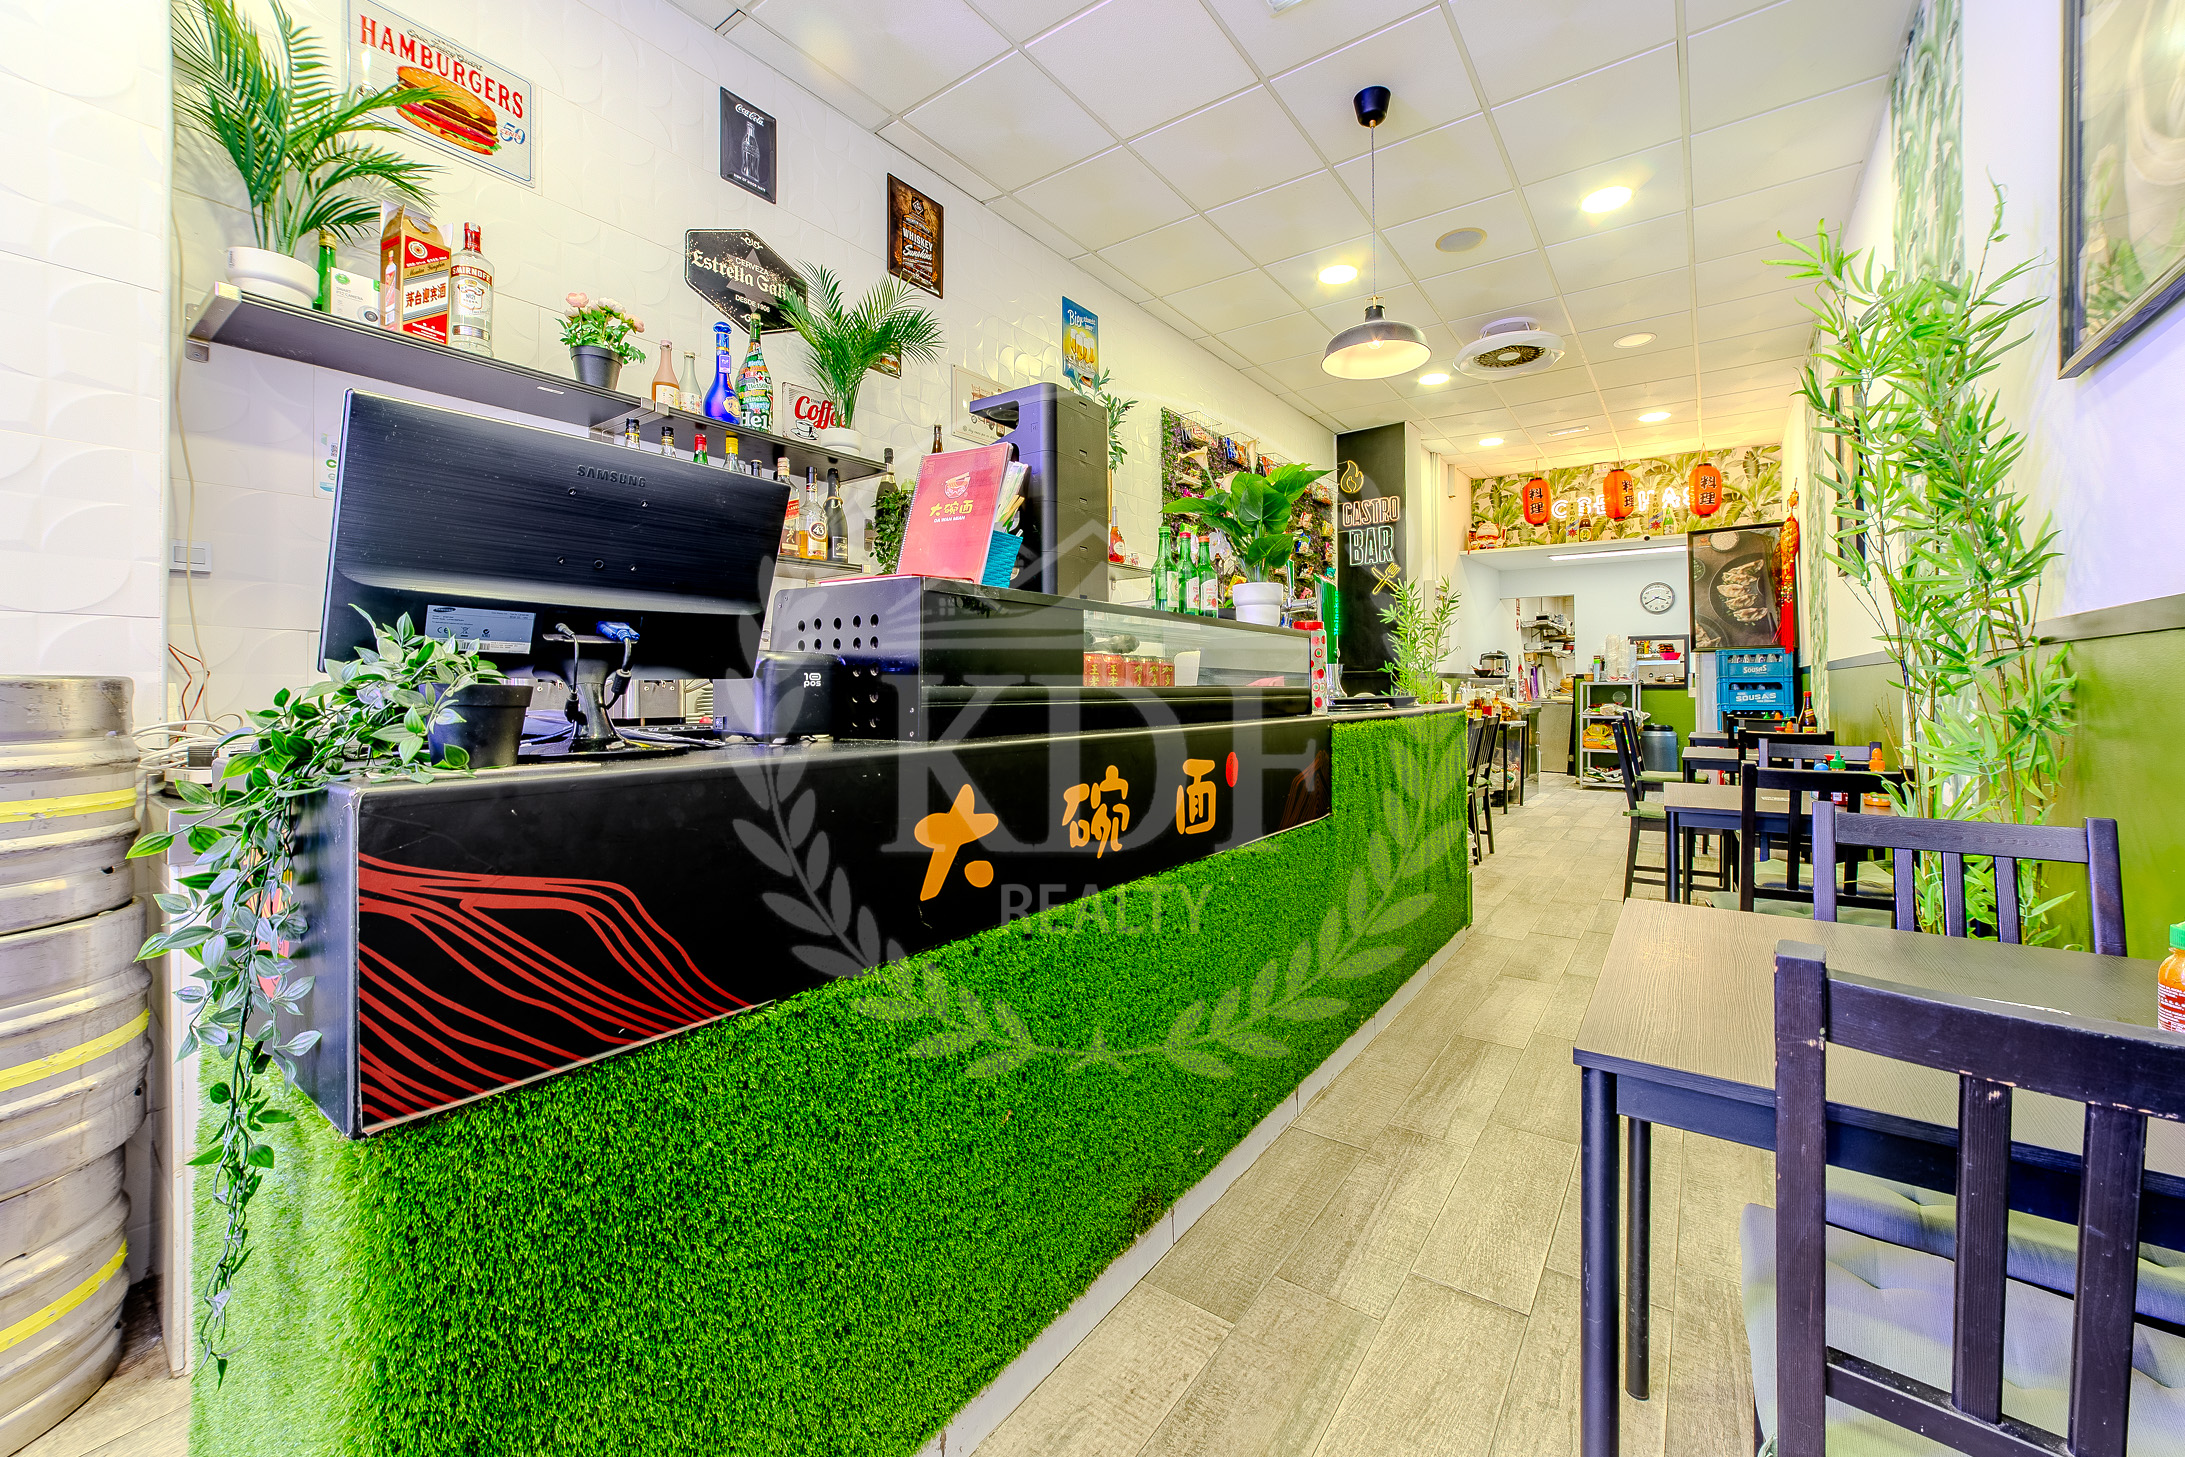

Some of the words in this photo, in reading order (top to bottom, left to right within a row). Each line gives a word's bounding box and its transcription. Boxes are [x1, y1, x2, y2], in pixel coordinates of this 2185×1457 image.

[359, 14, 523, 119] HAMBURGERS
[902, 228, 933, 252] WHISKEY
[452, 266, 491, 282] SMIRNOFF
[691, 249, 754, 287] Estrella
[735, 257, 769, 276] CERVEZA
[405, 282, 446, 308] 茅台迎宾酒
[735, 294, 757, 308] DESDE
[577, 465, 647, 488] SAMSUNG
[1528, 486, 1545, 515] 料理
[1699, 475, 1718, 506] 料理
[929, 500, 974, 517] 大碗面
[1342, 495, 1400, 527] GASTRO
[812, 525, 825, 535] 43
[1349, 526, 1393, 566] BAR
[1736, 692, 1777, 702] SOUSAS
[914, 759, 1217, 901] 大碗面
